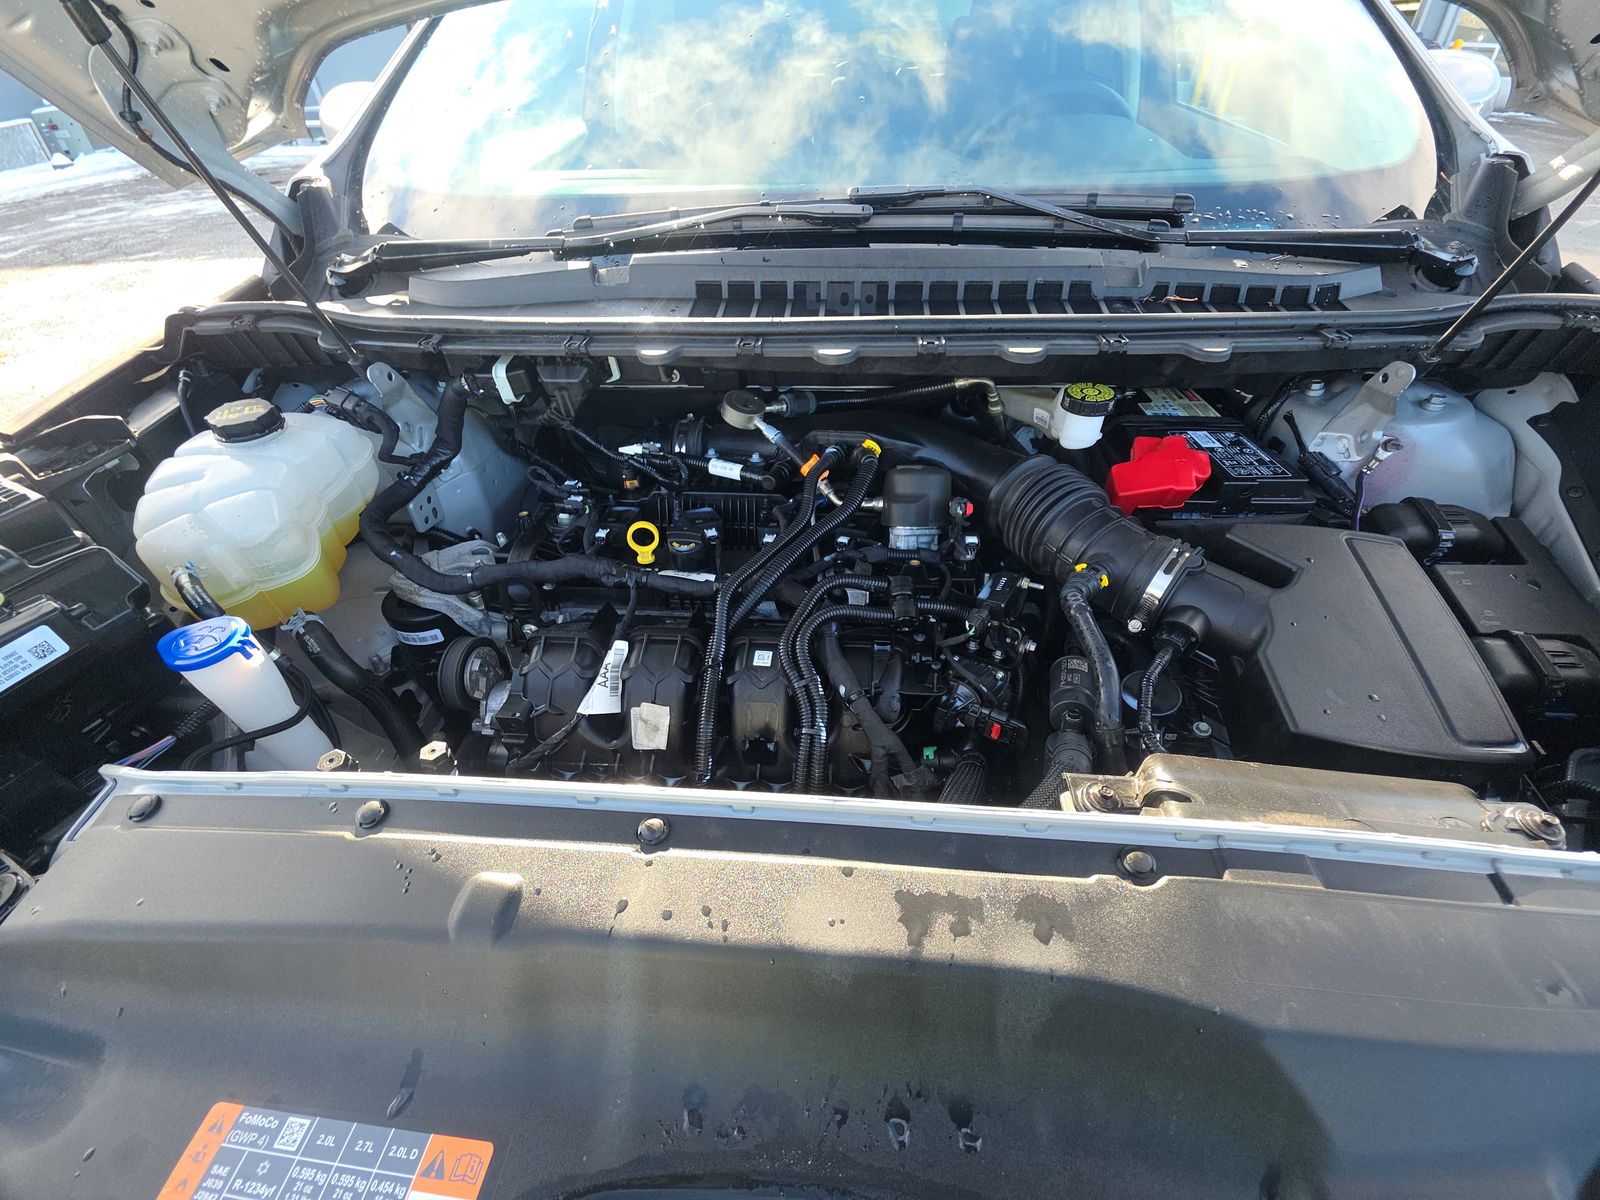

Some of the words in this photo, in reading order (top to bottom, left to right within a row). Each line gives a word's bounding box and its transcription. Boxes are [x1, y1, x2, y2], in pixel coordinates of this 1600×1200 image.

[239, 1112, 279, 1129] FoMoCo
[225, 1129, 258, 1145] (GWP
[257, 1134, 270, 1150] 4)
[316, 1134, 336, 1147] 2.0L
[354, 1140, 374, 1154] 2.7L
[388, 1145, 408, 1159] 2.0L
[409, 1148, 419, 1160] D
[210, 1164, 231, 1177] SAE
[291, 1166, 317, 1181] 0.595
[314, 1169, 328, 1186] kg
[202, 1177, 224, 1190] J639
[232, 1178, 277, 1199] R-1234yf
[292, 1181, 304, 1192] 21
[303, 1185, 314, 1194] oz
[331, 1172, 356, 1188] 0.595
[354, 1176, 367, 1193] kg
[370, 1179, 395, 1194] 0.454
[394, 1183, 407, 1200] kg
[332, 1187, 345, 1199] 21
